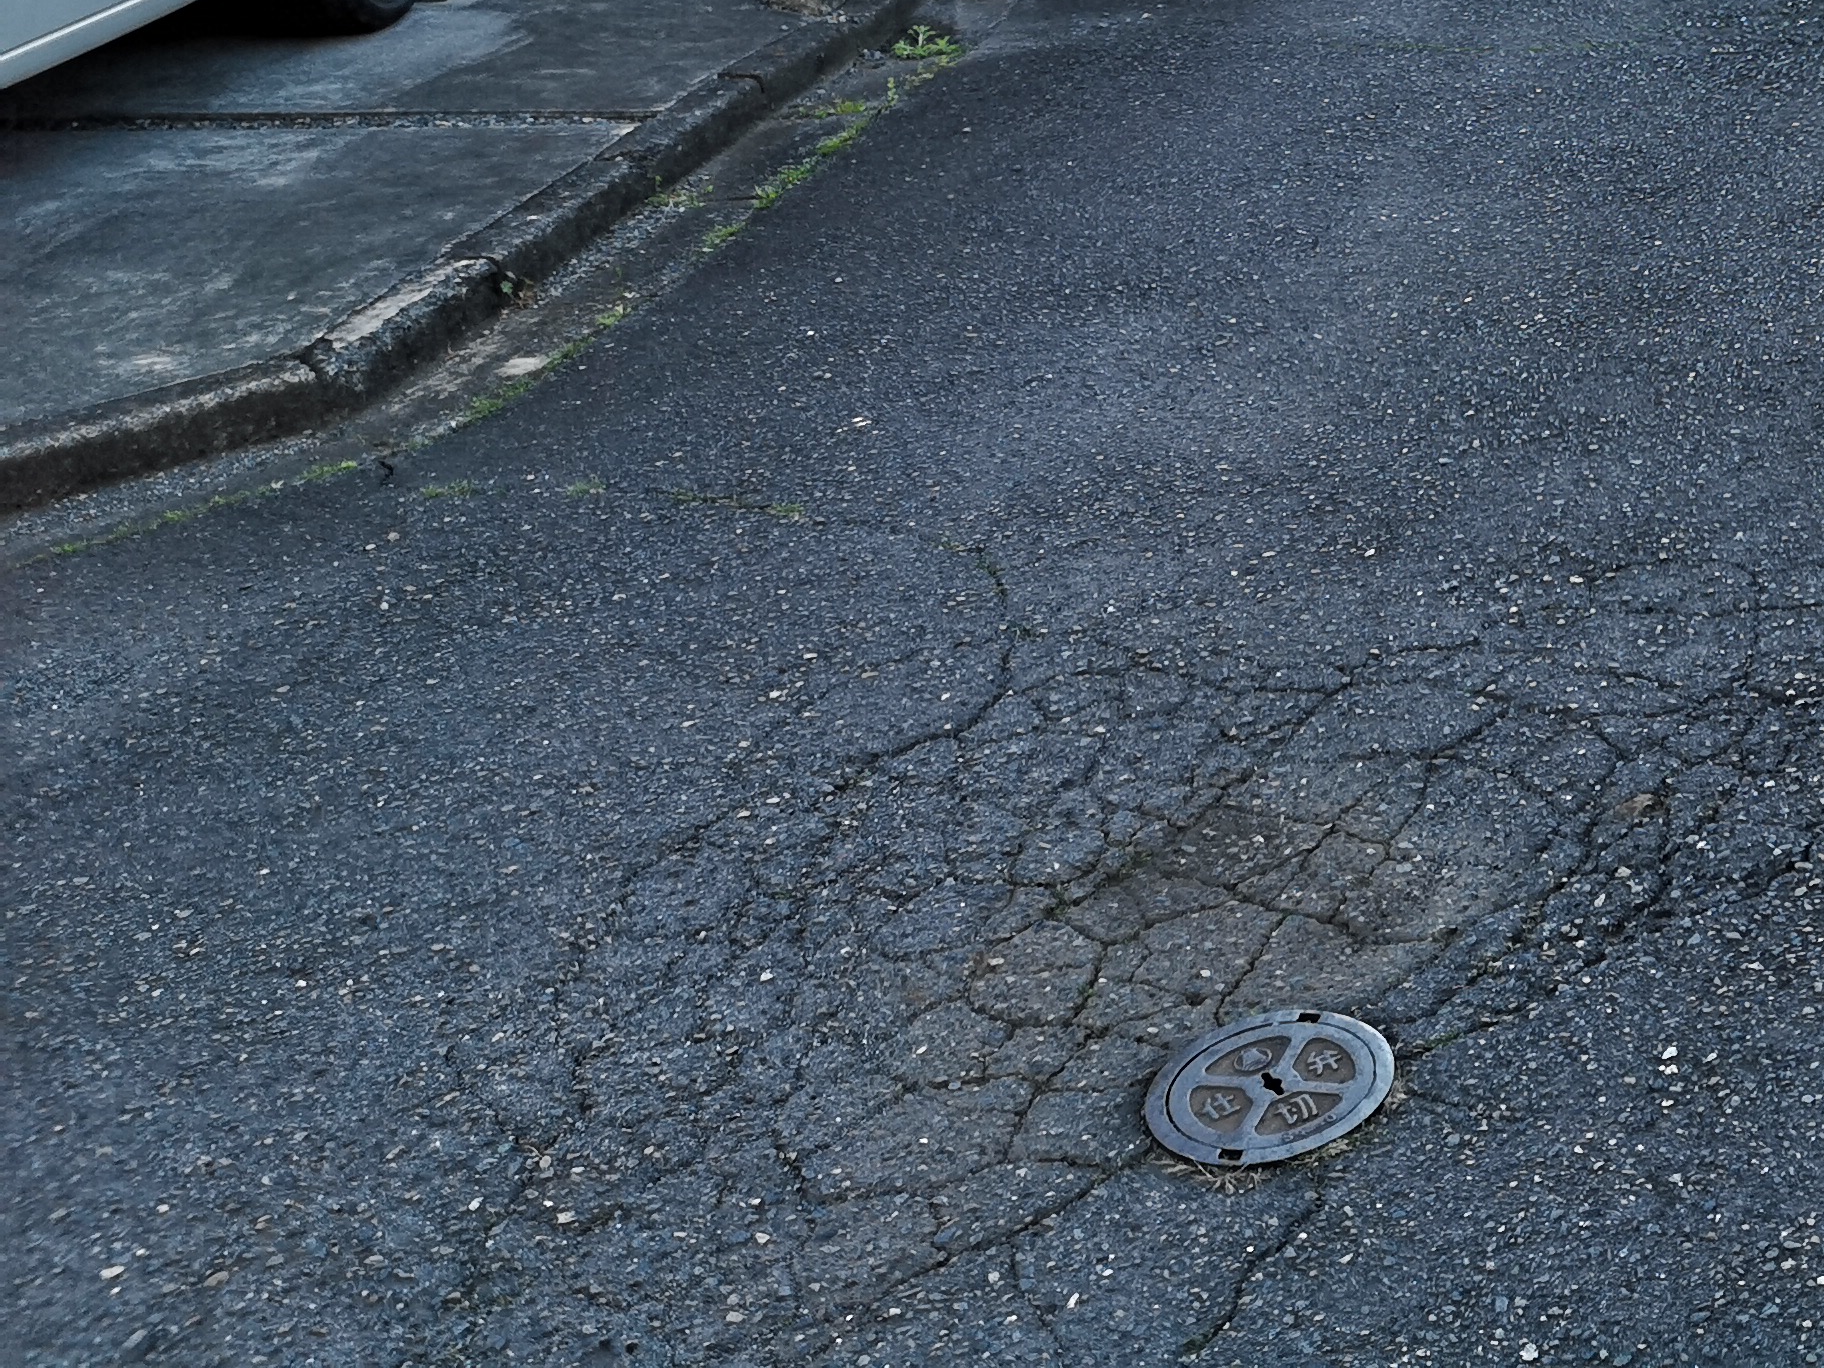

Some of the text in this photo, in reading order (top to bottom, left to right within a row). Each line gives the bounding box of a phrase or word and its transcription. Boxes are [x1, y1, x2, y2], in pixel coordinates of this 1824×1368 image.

[1307, 1049, 1343, 1075] 弁
[1202, 1093, 1318, 1124] 仕 切
